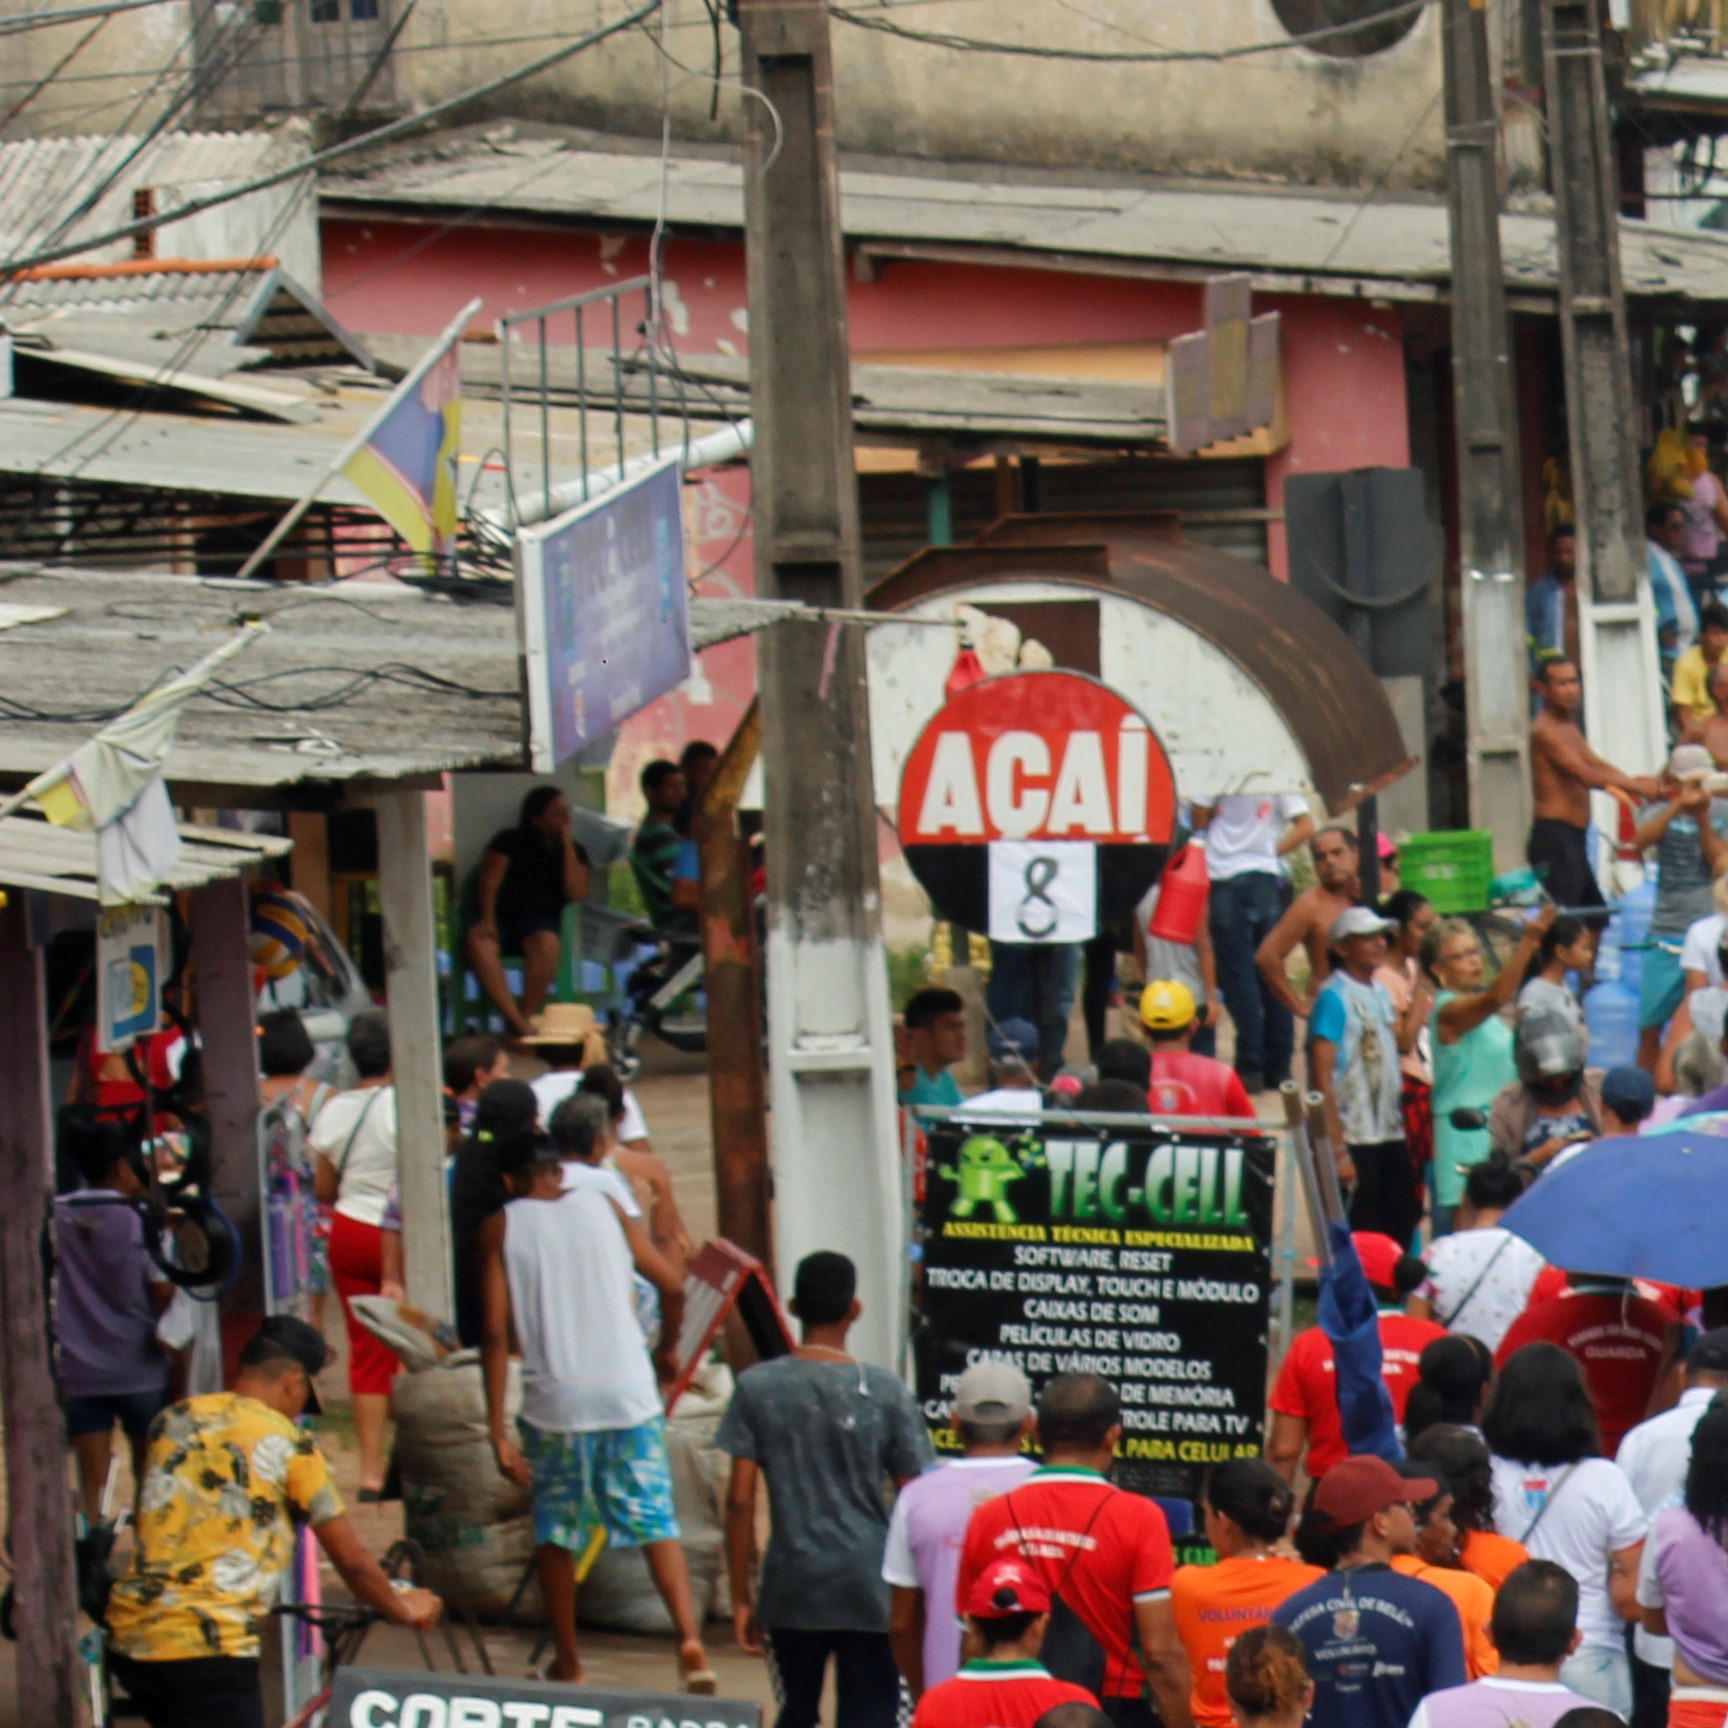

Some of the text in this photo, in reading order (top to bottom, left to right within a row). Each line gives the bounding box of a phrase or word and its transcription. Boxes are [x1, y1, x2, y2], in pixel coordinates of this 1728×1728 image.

[915, 712, 1150, 841] AÇAÍ
[1016, 856, 1059, 938] 8
[1044, 1140, 1249, 1227] TEC-CELL
[1013, 1245, 1173, 1272] SOFTWARE, RESET
[926, 1267, 1260, 1303] TROCA DE DISPLAY, TOUCH E MÓDULO
[1023, 1299, 1160, 1325] CAIXAS DE SOM
[999, 1322, 1182, 1352] PELÍCULAS DE VIDRO
[1027, 1351, 1052, 1373] DE
[1053, 1350, 1121, 1378] VÁRIOS
[1123, 1357, 1212, 1381] MODELOS
[1120, 1382, 1236, 1408] DE MEMÓRIA
[1173, 1412, 1223, 1434] PARA
[1224, 1414, 1249, 1435] TV
[1126, 1438, 1176, 1461] PARA
